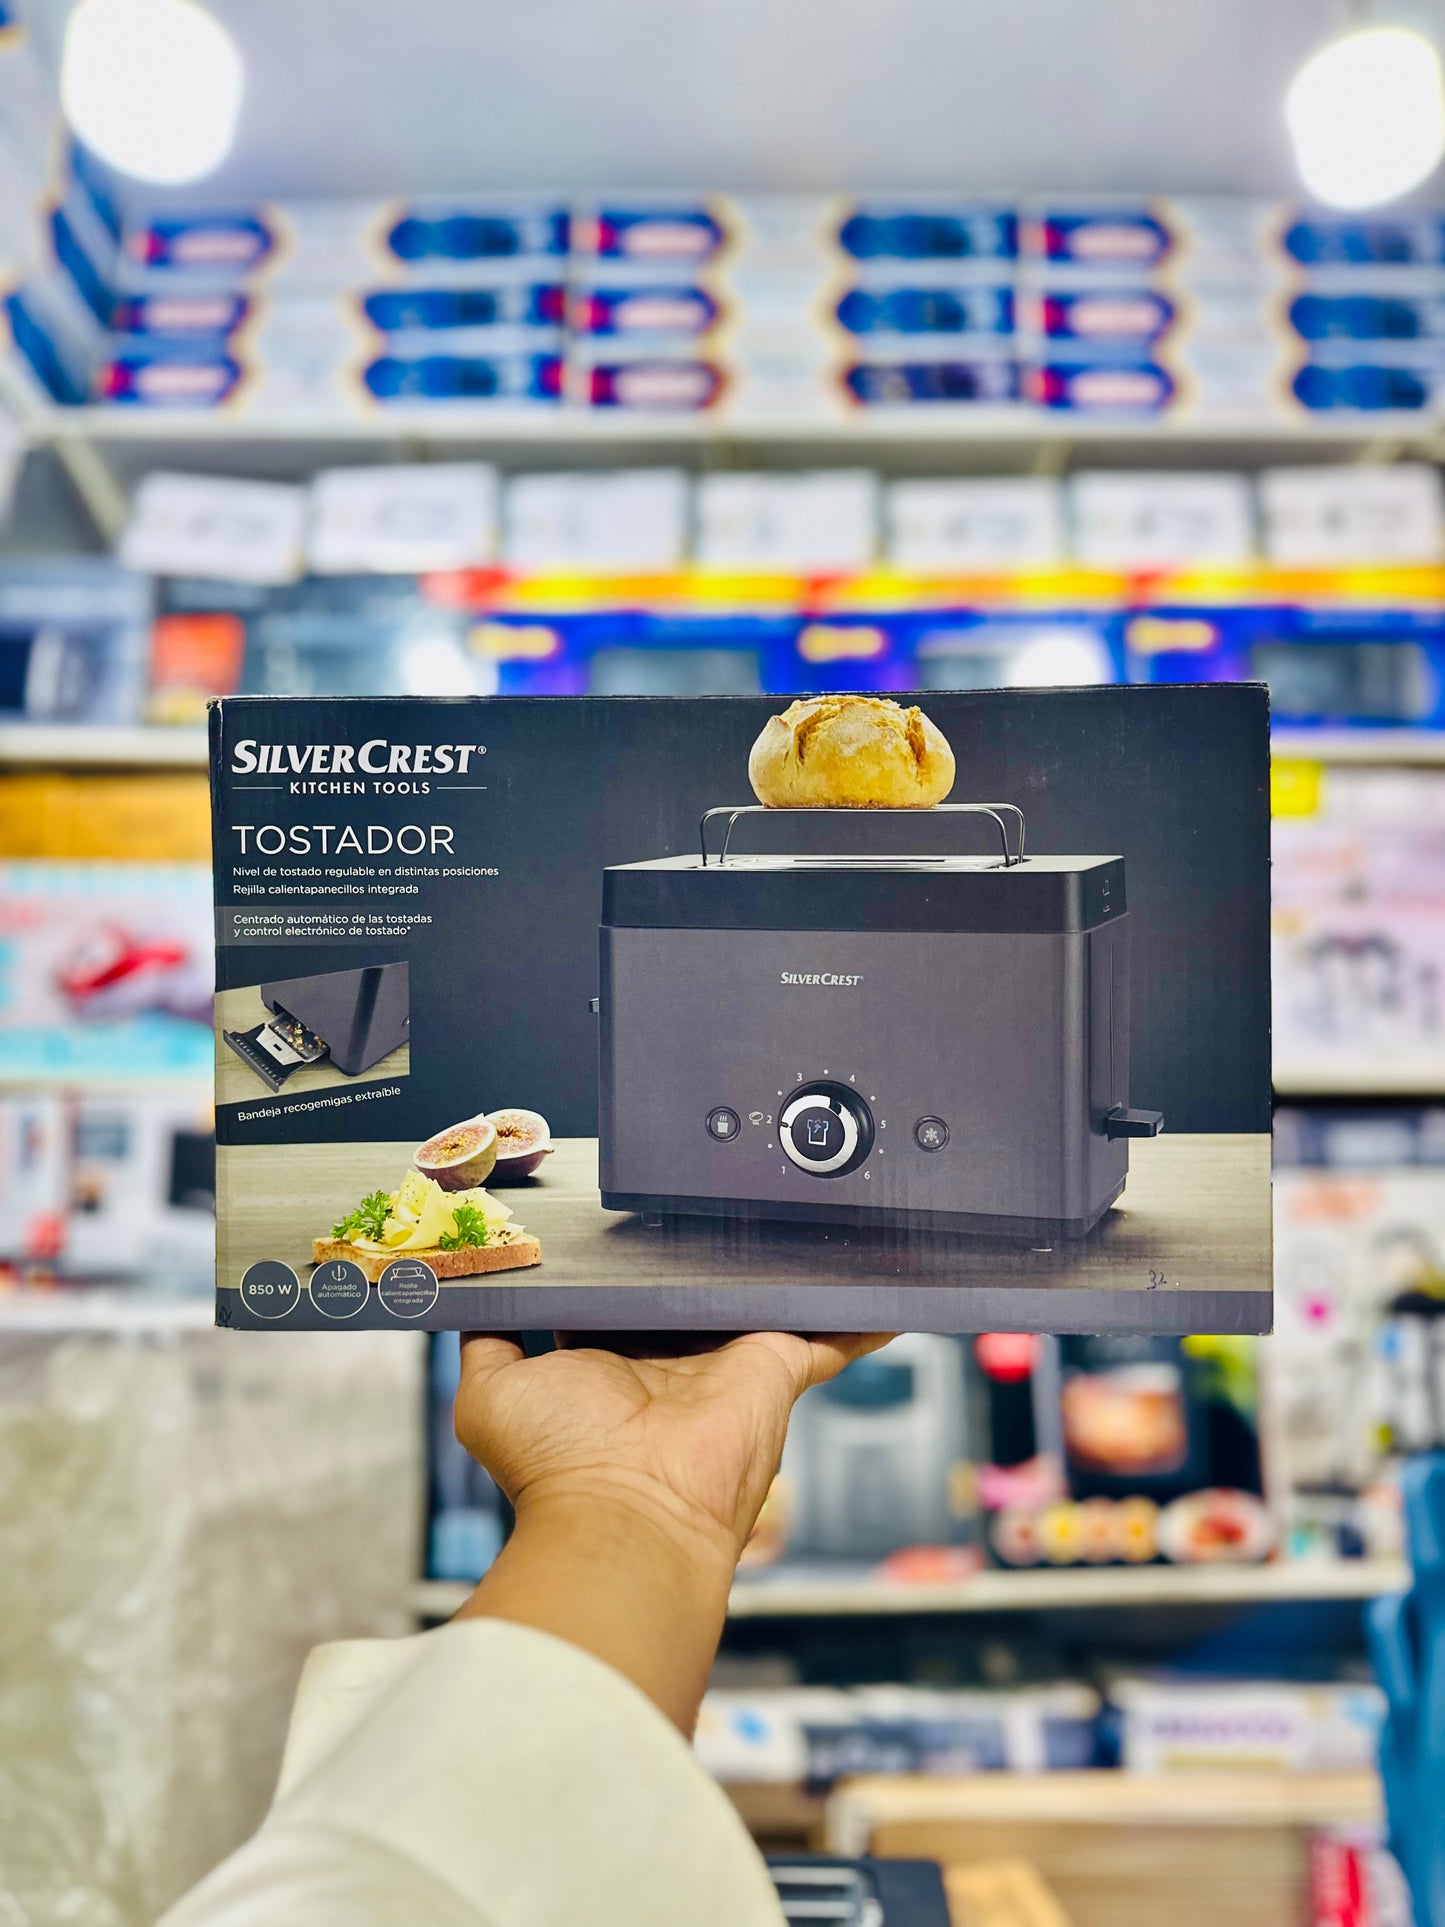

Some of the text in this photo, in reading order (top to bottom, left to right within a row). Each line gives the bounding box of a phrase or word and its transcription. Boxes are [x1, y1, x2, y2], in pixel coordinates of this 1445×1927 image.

[290, 781, 431, 795] KITCHEN TOOLS
[231, 825, 455, 855] TOSTADOR
[233, 866, 499, 879] Nivel de tostado regulable en distintas posiciones
[233, 884, 419, 896] Rejilla calientapanecillos integrada
[233, 913, 433, 925] Centrado automático de las tostadas
[233, 928, 241, 938] y
[243, 926, 282, 937] control
[285, 926, 346, 936] electrónico
[348, 926, 363, 936] de
[796, 1072, 803, 1082] 3
[849, 1074, 856, 1084] 4
[237, 1086, 402, 1122] Bandeja recogemigas extraíble
[766, 1114, 773, 1124] 2
[880, 1120, 887, 1129] 5
[781, 1166, 786, 1175] 1
[864, 1170, 871, 1180] 6
[248, 1284, 293, 1296] 850 W
[317, 1289, 362, 1298] automático
[321, 1283, 358, 1293] Apagado
